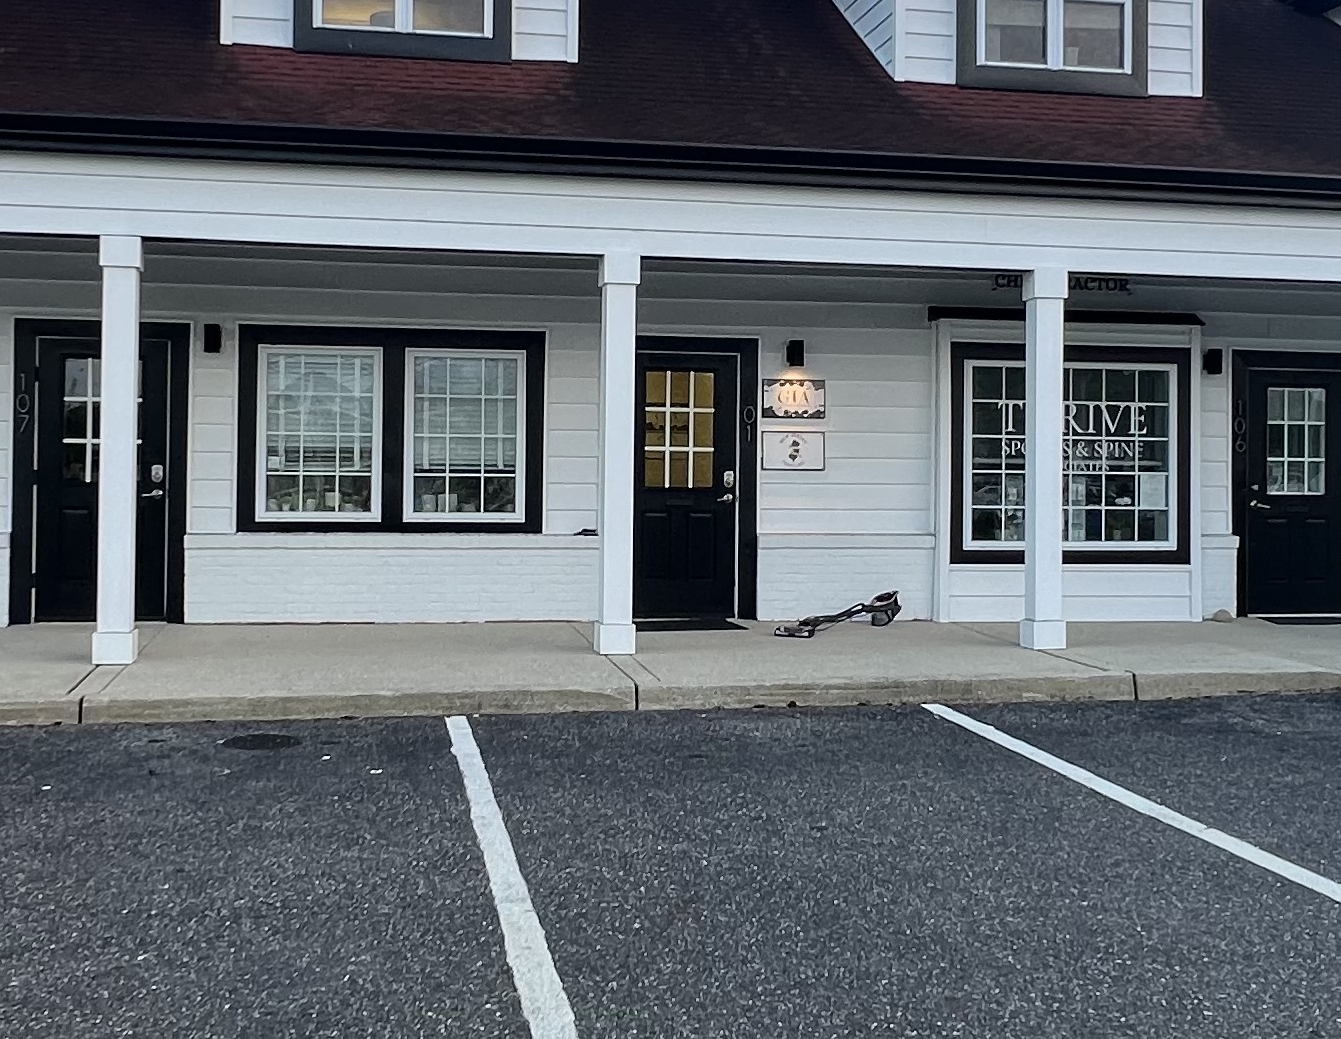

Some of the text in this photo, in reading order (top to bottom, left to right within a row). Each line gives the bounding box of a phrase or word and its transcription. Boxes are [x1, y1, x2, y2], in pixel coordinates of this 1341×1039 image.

[994, 274, 1131, 292] CHACTOR
[16, 373, 31, 433] 107
[998, 400, 1147, 435] TRIVE
[1234, 399, 1247, 453] 106
[1001, 440, 1071, 457] SPS
[1075, 441, 1089, 457] &
